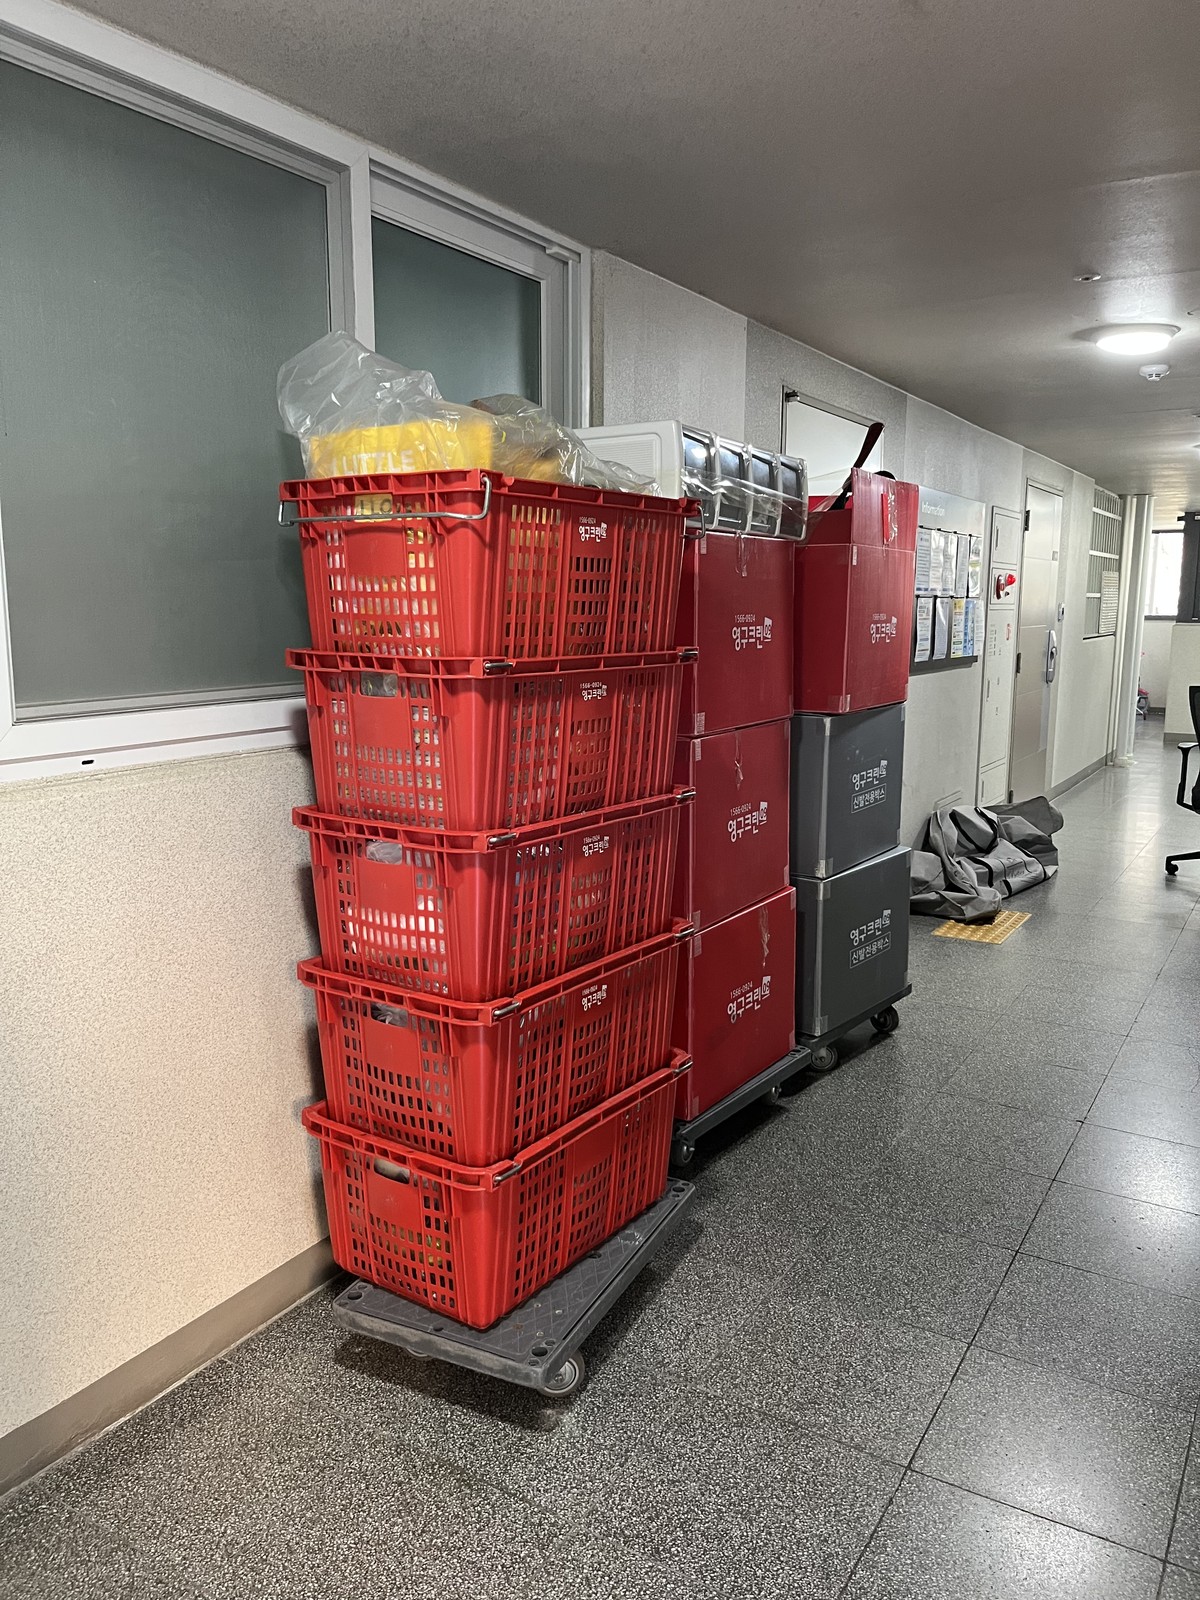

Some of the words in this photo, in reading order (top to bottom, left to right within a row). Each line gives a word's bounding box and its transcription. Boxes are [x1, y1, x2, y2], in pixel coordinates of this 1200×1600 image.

[342, 449, 416, 476] LITTLE
[578, 525, 601, 542] 영구크린
[734, 614, 756, 623] 1566-0924
[732, 625, 764, 651] 영구크린
[870, 623, 891, 644] 영구크린
[581, 688, 602, 701] 영구크린
[852, 767, 880, 791] 영구크린
[853, 787, 885, 809] 신발전용박스
[730, 802, 752, 817] 1566-0924
[727, 810, 759, 843] 영구크린
[582, 841, 604, 857] 영구크린
[850, 917, 882, 946] 영구크린
[851, 936, 890, 964] 신발전용박스
[730, 980, 753, 999] 1566-0924
[581, 990, 602, 1012] 영구크린
[727, 986, 761, 1024] 영구크린
